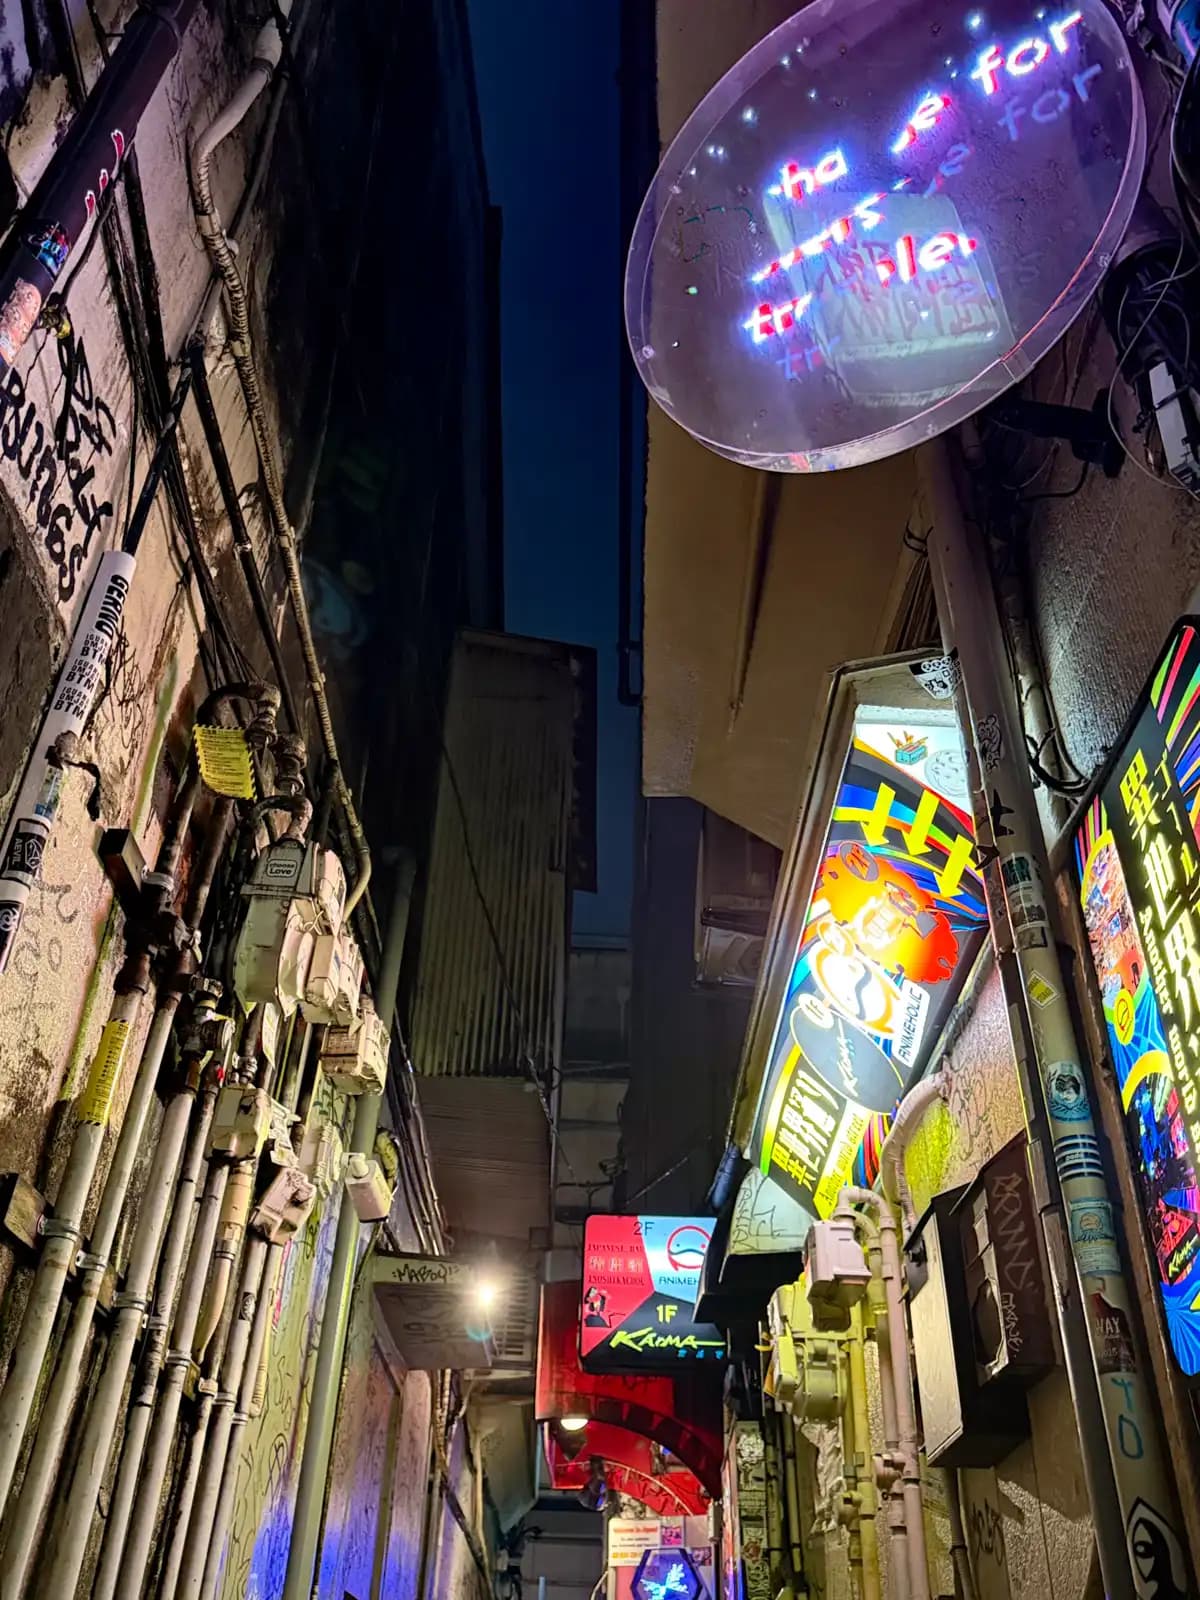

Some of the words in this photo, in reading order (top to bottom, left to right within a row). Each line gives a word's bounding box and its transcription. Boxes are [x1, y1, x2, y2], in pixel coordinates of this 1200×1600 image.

[972, 11, 1083, 95] for
[65, 671, 96, 693] BTM
[53, 700, 85, 720] BTM
[269, 862, 295, 870] choose
[1139, 904, 1174, 1015] Another
[1168, 1023, 1198, 1115] world
[898, 987, 923, 1062] ANIMEHOLIC
[770, 1069, 839, 1192] 異世界通り
[633, 1221, 655, 1236] 2F
[656, 1304, 678, 1323] 1F
